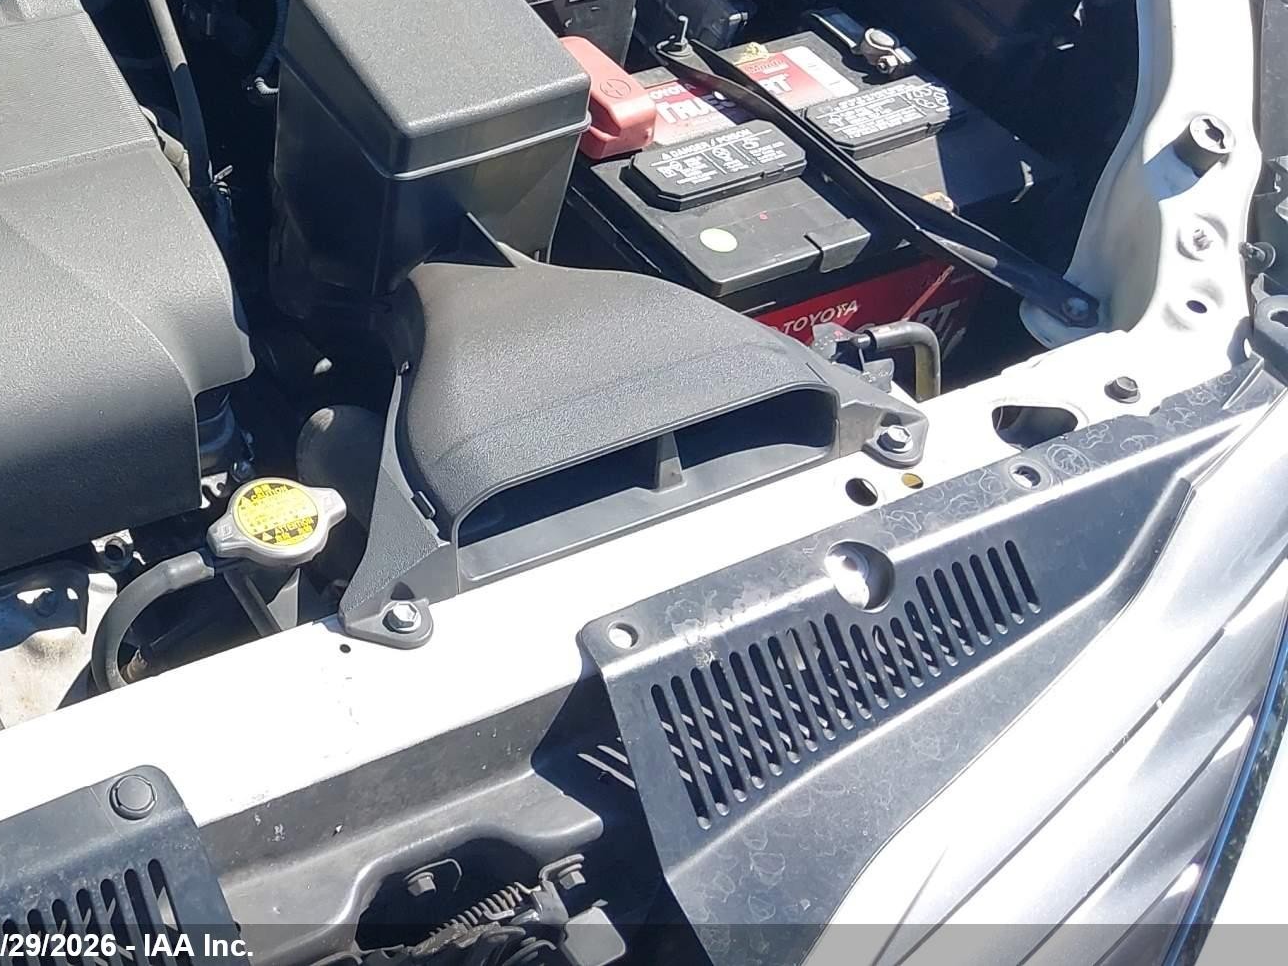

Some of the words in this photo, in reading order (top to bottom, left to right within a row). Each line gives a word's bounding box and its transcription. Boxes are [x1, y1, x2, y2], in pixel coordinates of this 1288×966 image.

[670, 140, 712, 158] DANGER
[715, 128, 753, 145] POISON
[783, 300, 858, 335] TOYOTA
